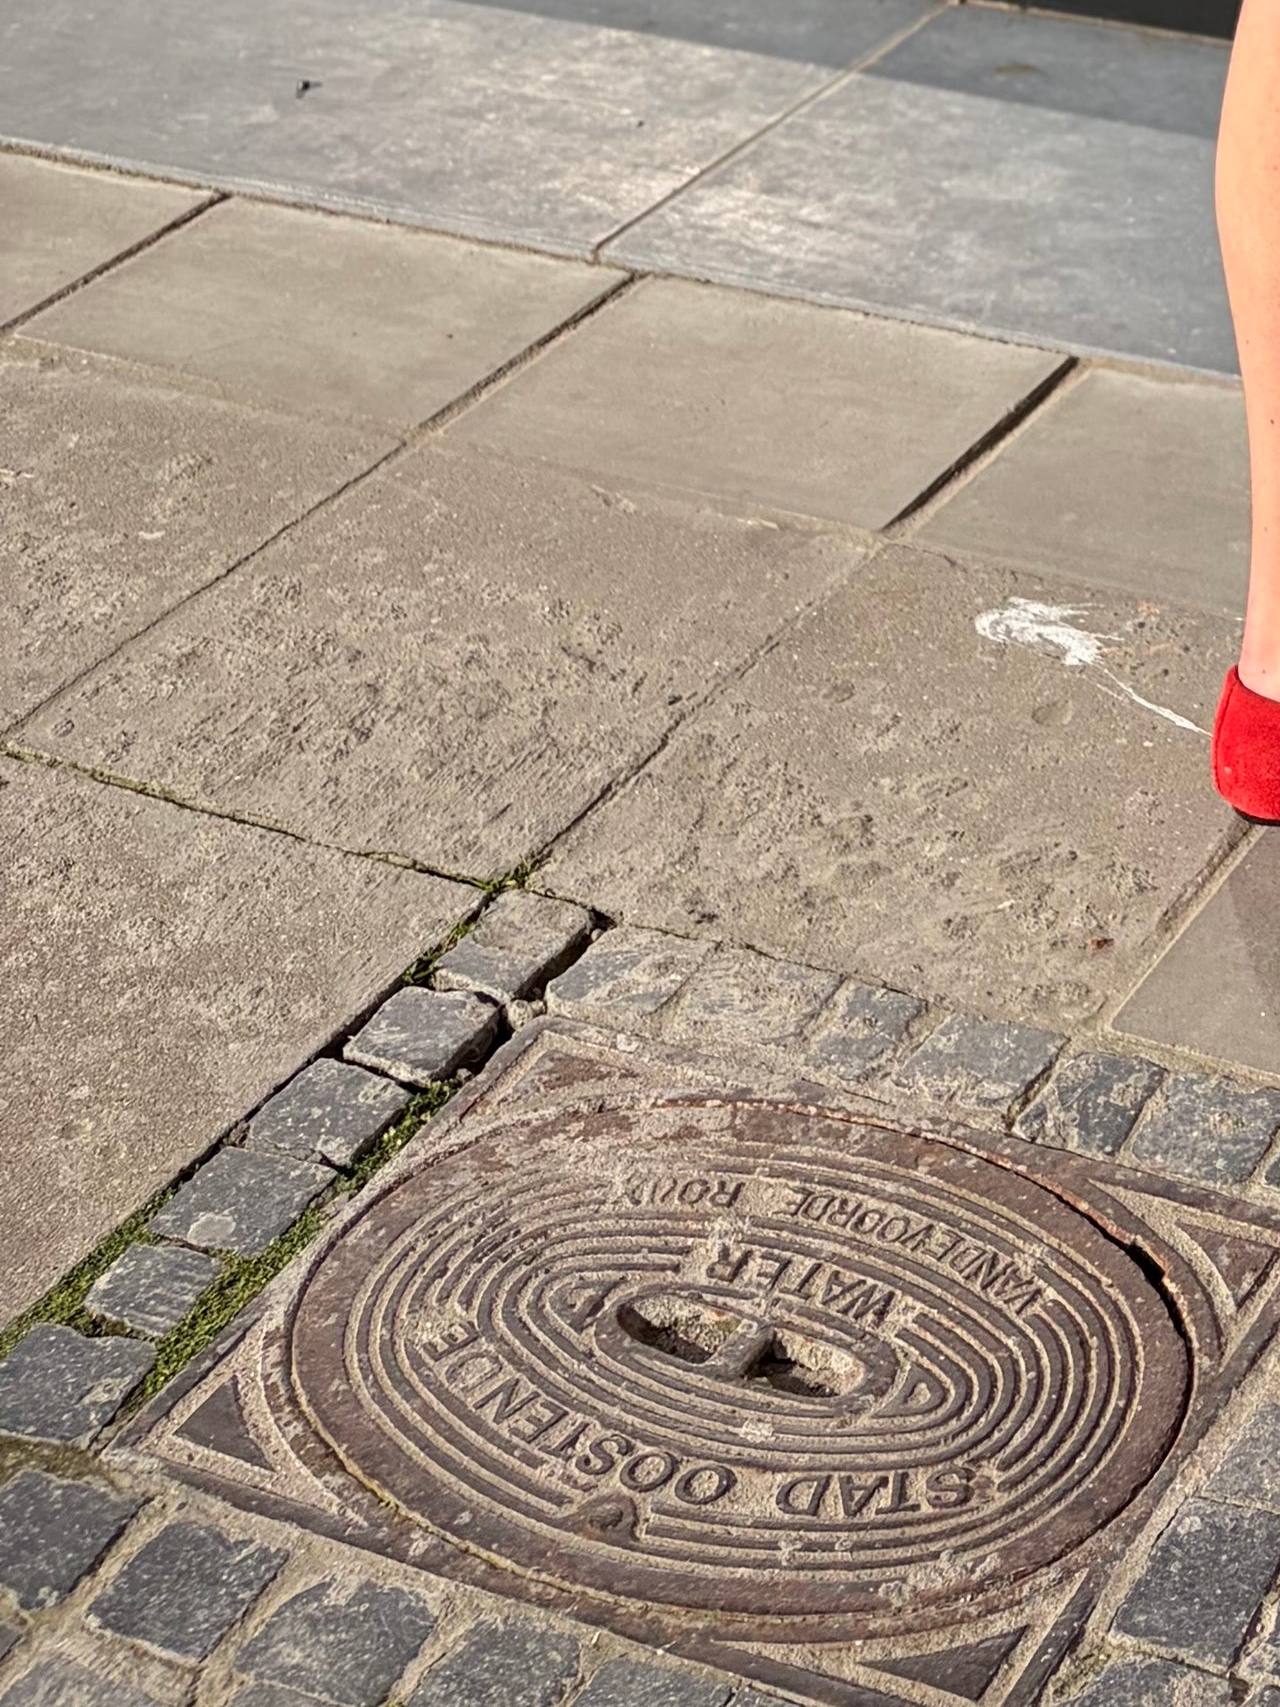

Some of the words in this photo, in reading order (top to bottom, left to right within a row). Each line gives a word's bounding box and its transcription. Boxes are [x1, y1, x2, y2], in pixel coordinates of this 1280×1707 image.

[706, 1244, 897, 1323] WATER
[777, 1187, 1042, 1317] VANDEVOORDE
[424, 1321, 738, 1507] OOSTENDE
[775, 1464, 977, 1518] STAD
